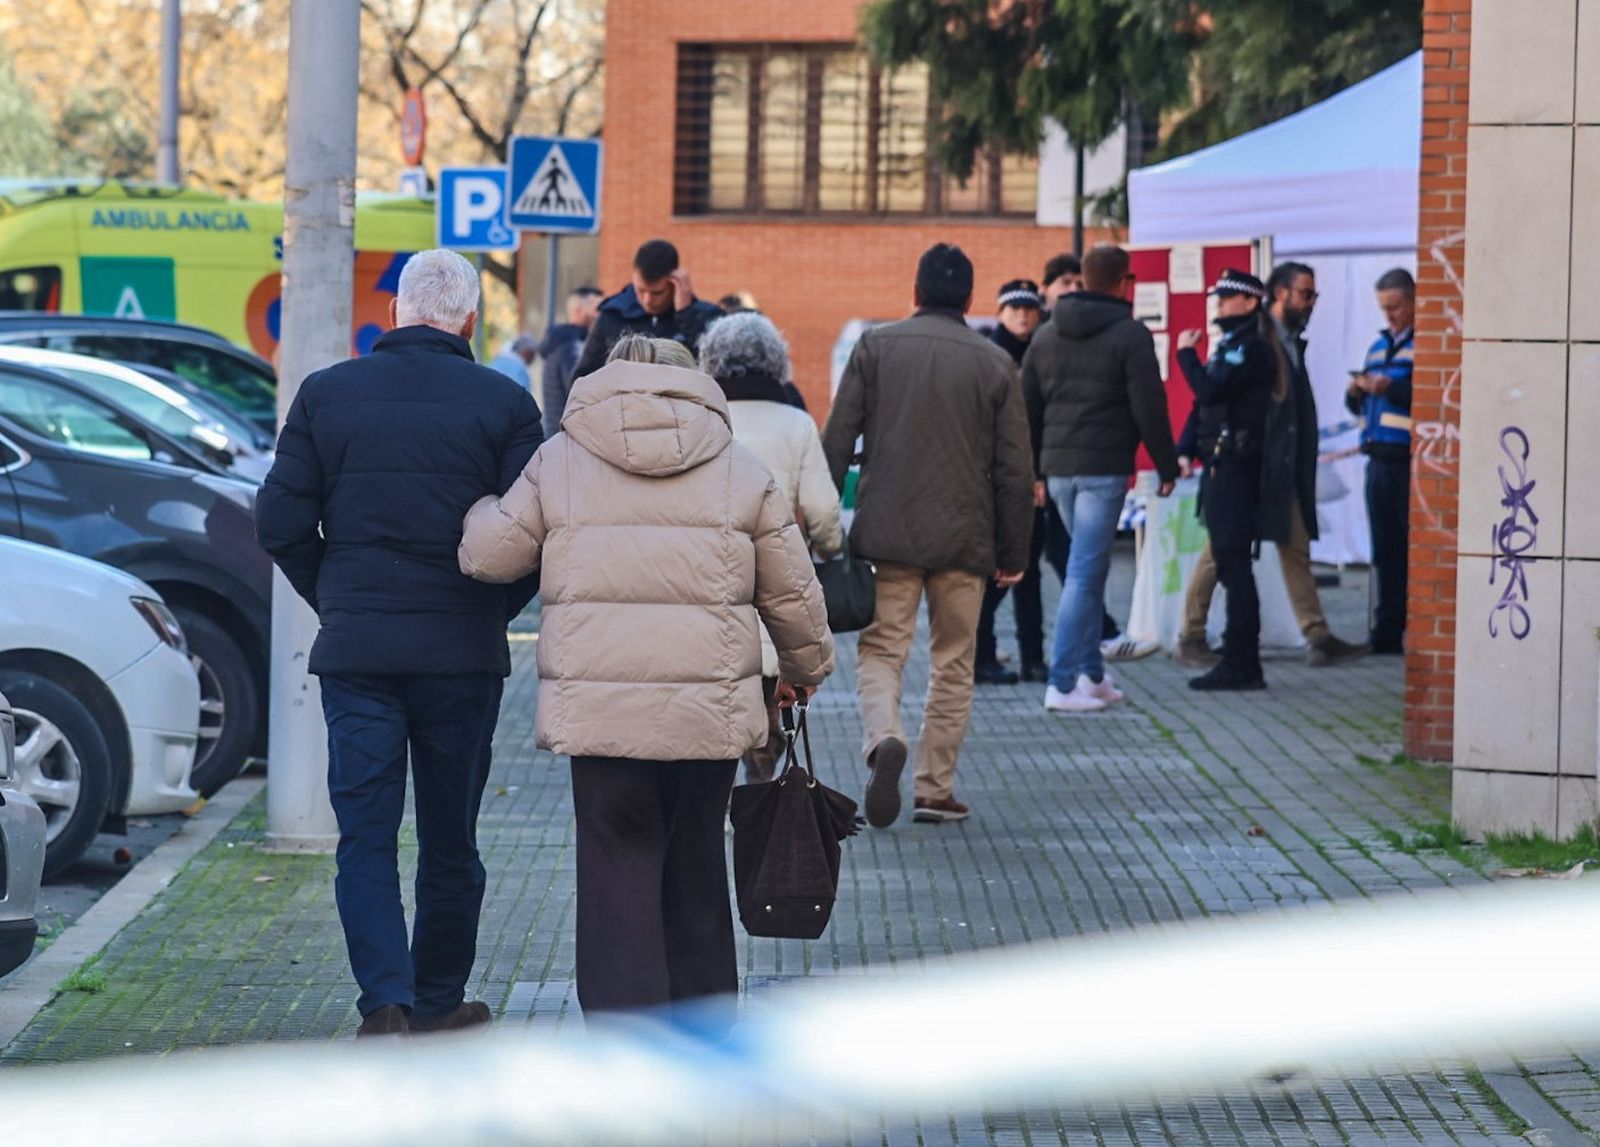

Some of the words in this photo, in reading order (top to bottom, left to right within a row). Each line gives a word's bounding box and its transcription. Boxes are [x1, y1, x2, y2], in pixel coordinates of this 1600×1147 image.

[91, 208, 250, 232] AMBULANCIA
[453, 176, 502, 238] P
[113, 286, 146, 319] A
